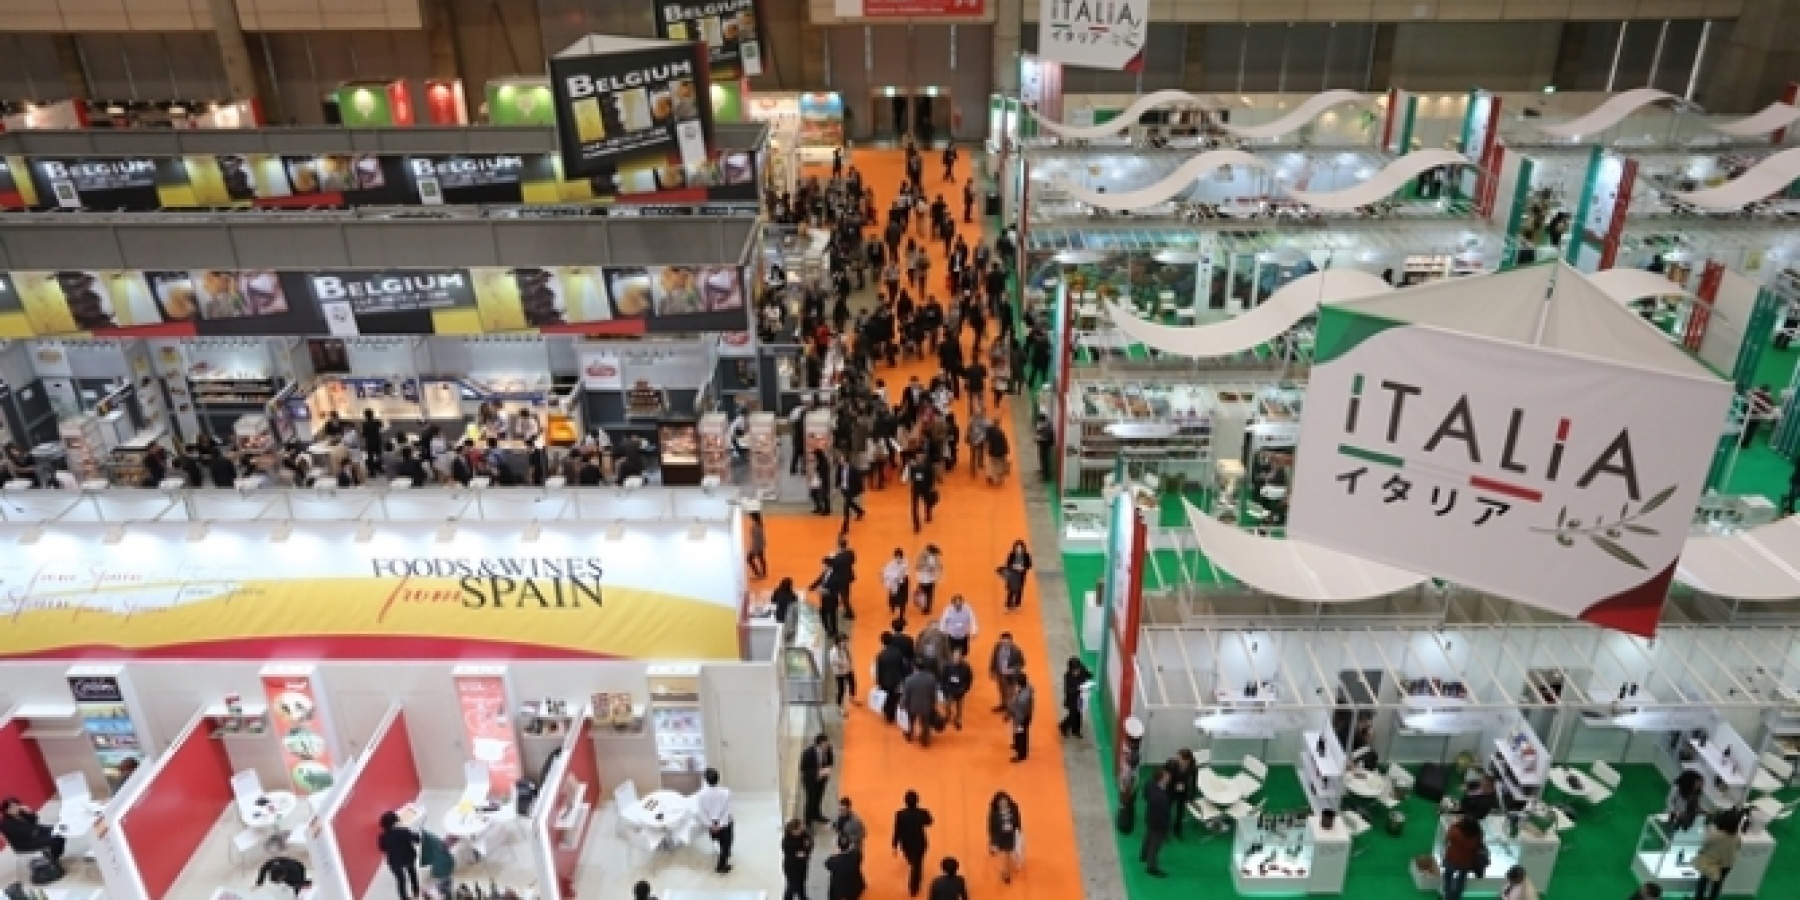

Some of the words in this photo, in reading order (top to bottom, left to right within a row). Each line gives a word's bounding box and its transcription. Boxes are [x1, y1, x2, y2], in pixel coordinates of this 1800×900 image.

[567, 60, 691, 97] BELGIUM
[313, 273, 463, 299] BELGIUM
[1335, 467, 1512, 526] イタリア
[459, 575, 603, 608] SPAIN
